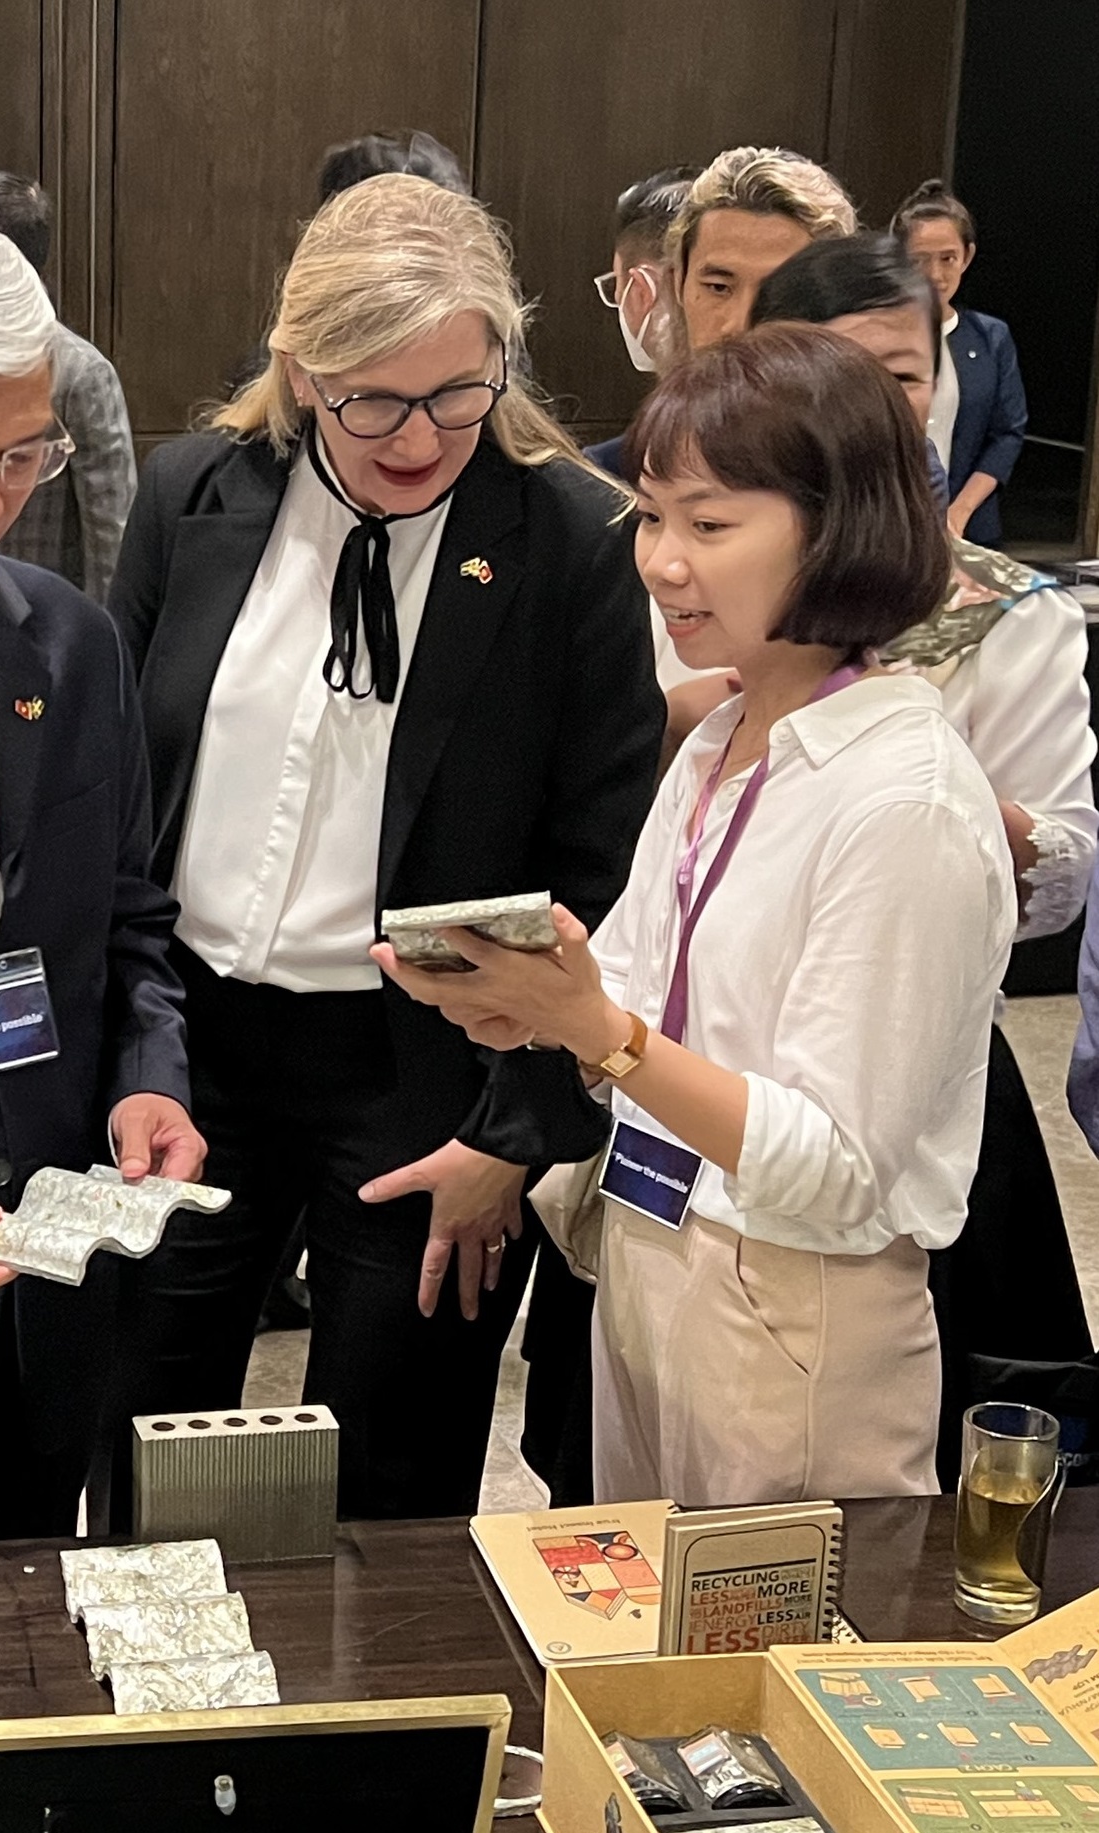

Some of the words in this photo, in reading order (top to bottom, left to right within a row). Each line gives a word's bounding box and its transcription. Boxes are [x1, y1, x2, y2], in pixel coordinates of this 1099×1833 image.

[690, 1590, 730, 1606] LESS
[757, 1580, 811, 1599] MORE
[691, 1570, 780, 1592] RECYCLING
[703, 1599, 782, 1619] LANDFILLS
[784, 1594, 813, 1604] MORE
[694, 1613, 759, 1634] ENERGY
[756, 1609, 795, 1625] LESS
[794, 1611, 811, 1620] AIR
[686, 1626, 761, 1655] LESS
[762, 1620, 811, 1640] DIRTY
